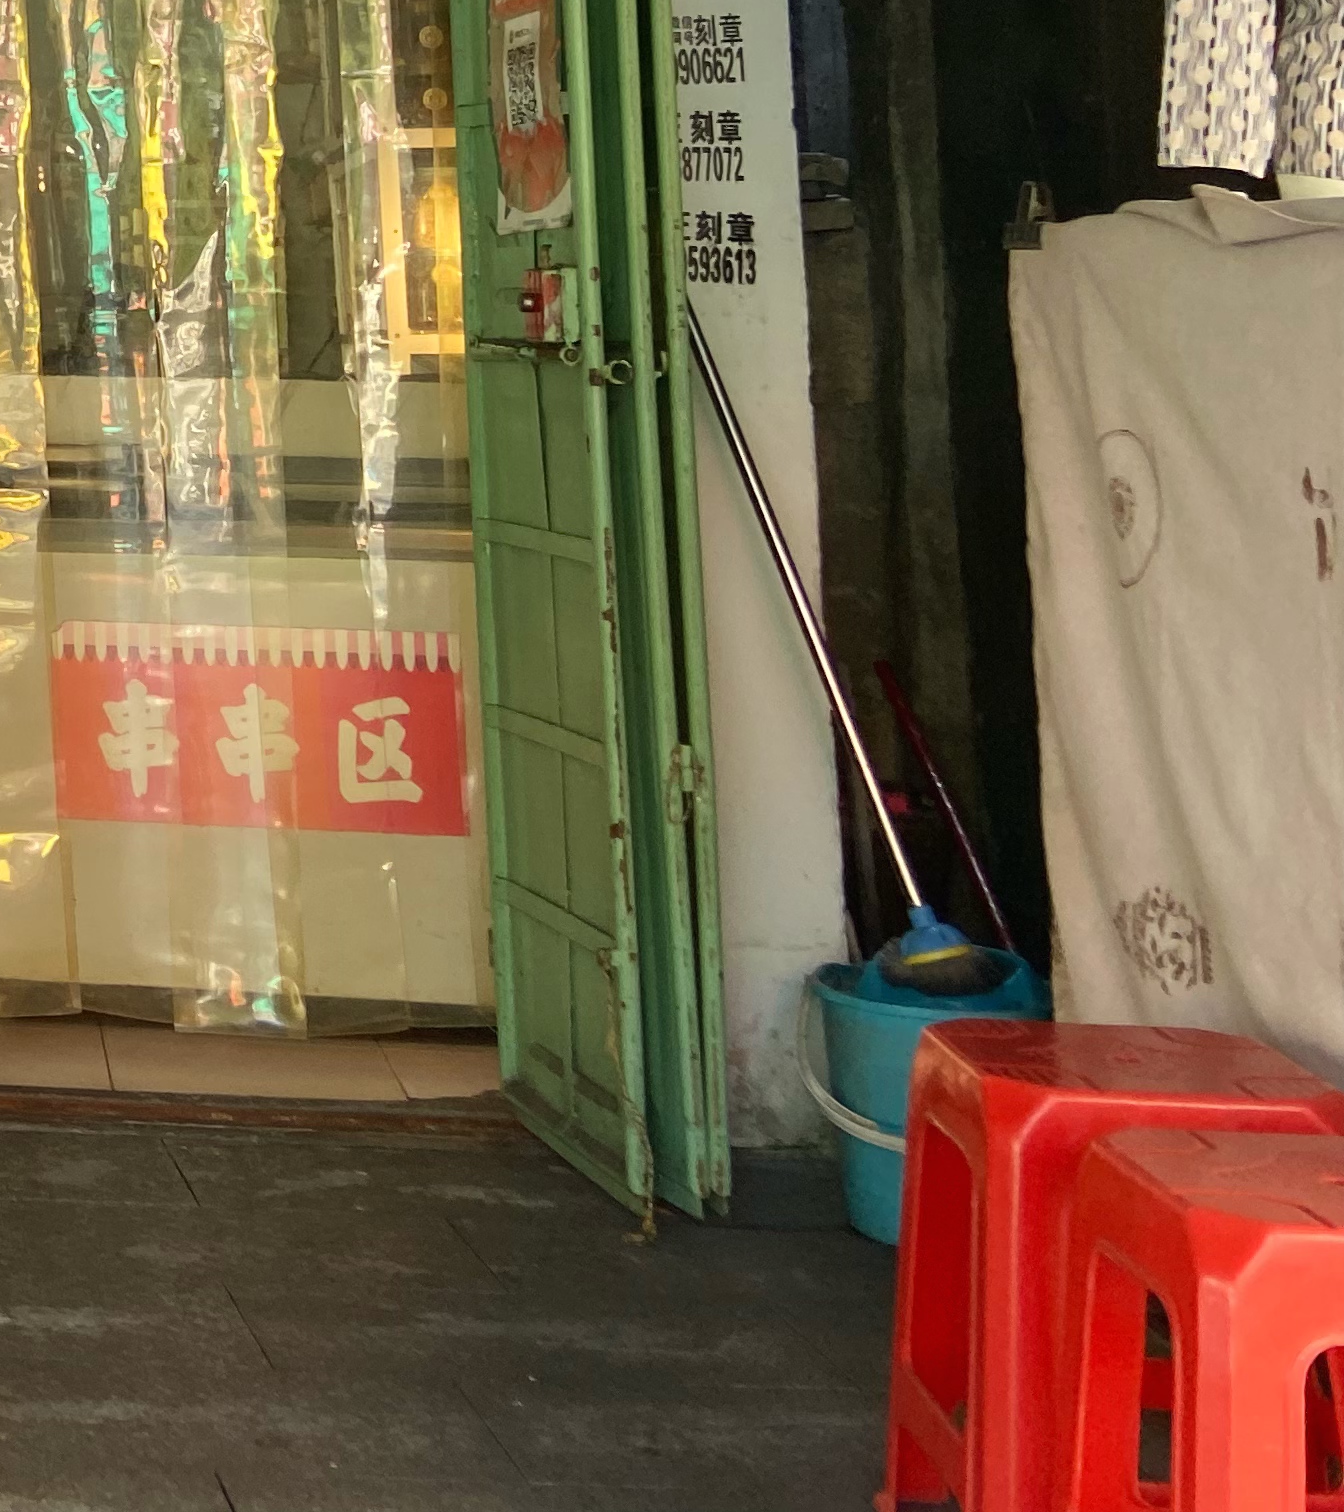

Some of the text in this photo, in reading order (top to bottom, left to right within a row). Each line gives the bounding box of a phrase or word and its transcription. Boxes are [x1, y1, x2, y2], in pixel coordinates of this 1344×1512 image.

[675, 47, 745, 85] 906621
[677, 110, 742, 145] 刻章
[682, 146, 744, 182] 877072
[687, 246, 756, 285] 593613
[97, 679, 424, 804] 串串区
